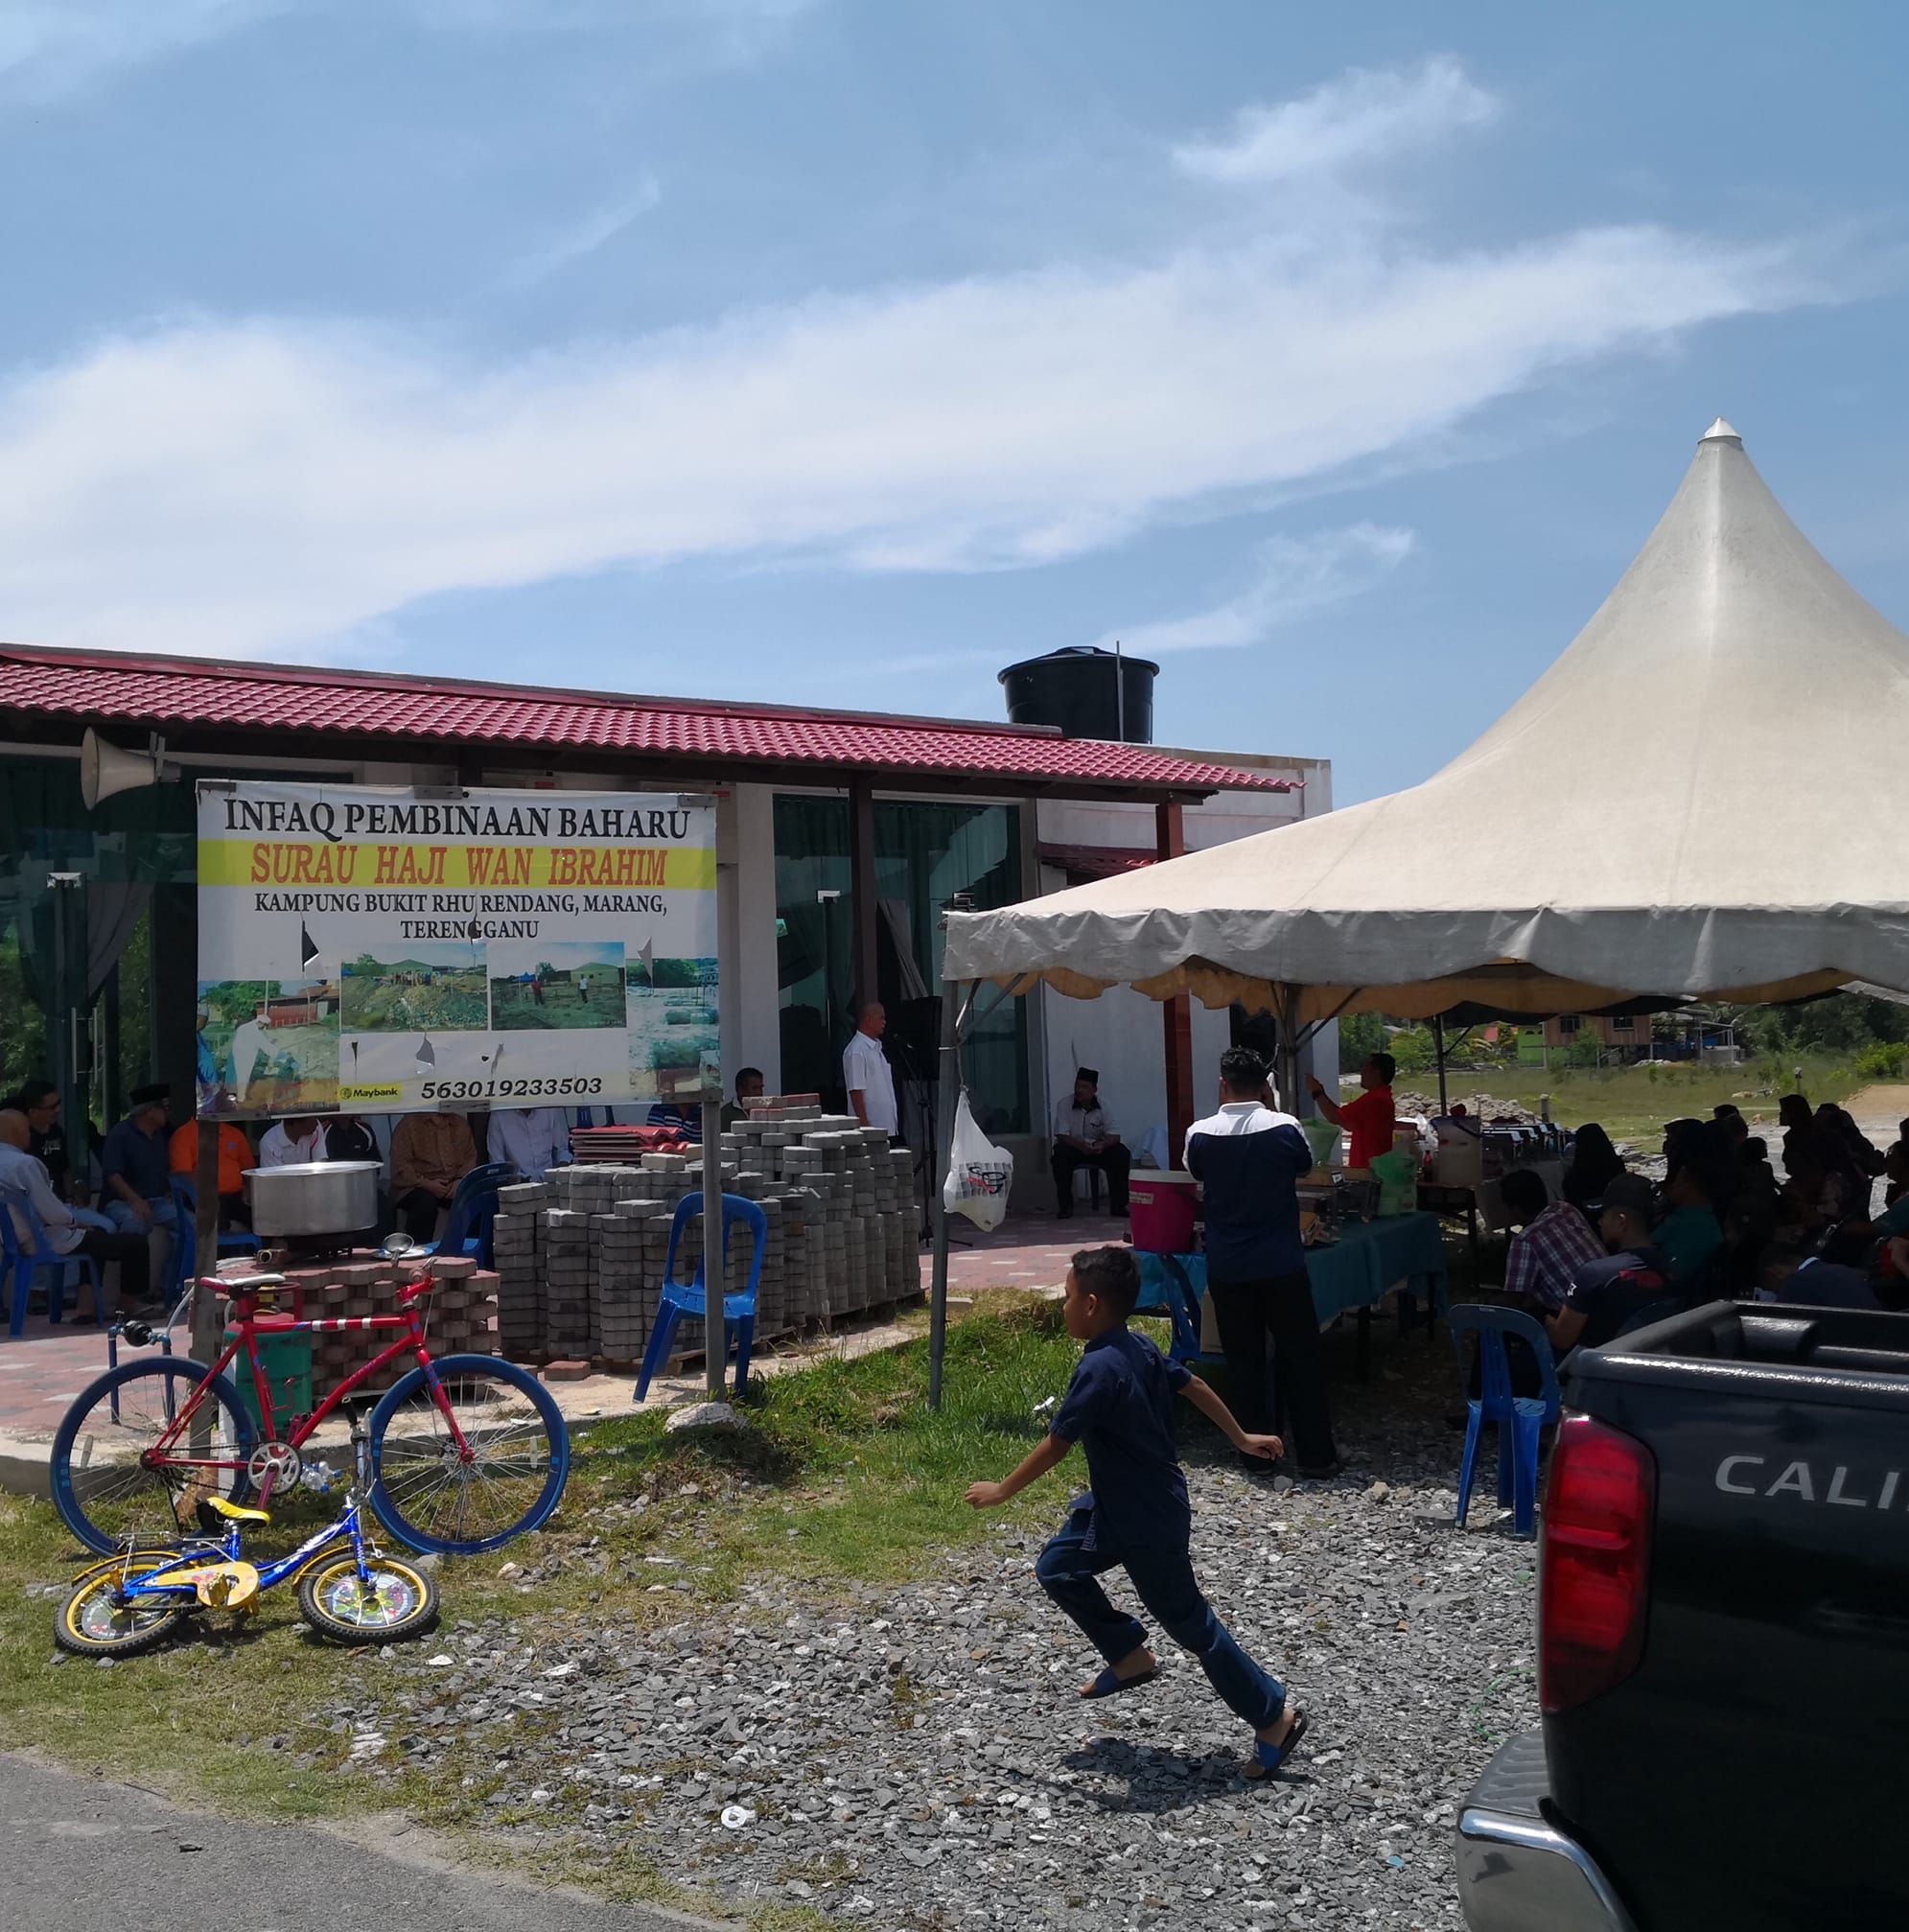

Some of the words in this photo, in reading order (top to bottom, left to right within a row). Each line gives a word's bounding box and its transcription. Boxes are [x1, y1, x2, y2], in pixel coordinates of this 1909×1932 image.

[224, 799, 342, 842] INFAQ
[344, 804, 549, 836] PEMBINAAN
[556, 808, 691, 840] BAHARU
[251, 843, 359, 885] SURAU
[375, 845, 448, 886] HAJI
[466, 847, 534, 886] WAN
[547, 849, 668, 886] IBRAHIM
[254, 893, 361, 913] KAMPUNG
[364, 894, 428, 914] BUKIT
[431, 895, 476, 914] RHU
[479, 894, 580, 916] RENDANG,
[582, 894, 668, 916] MARANG,
[352, 1087, 399, 1099] Maybank
[421, 1078, 602, 1100] 563019233503
[1715, 1455, 1909, 1512] CALI
